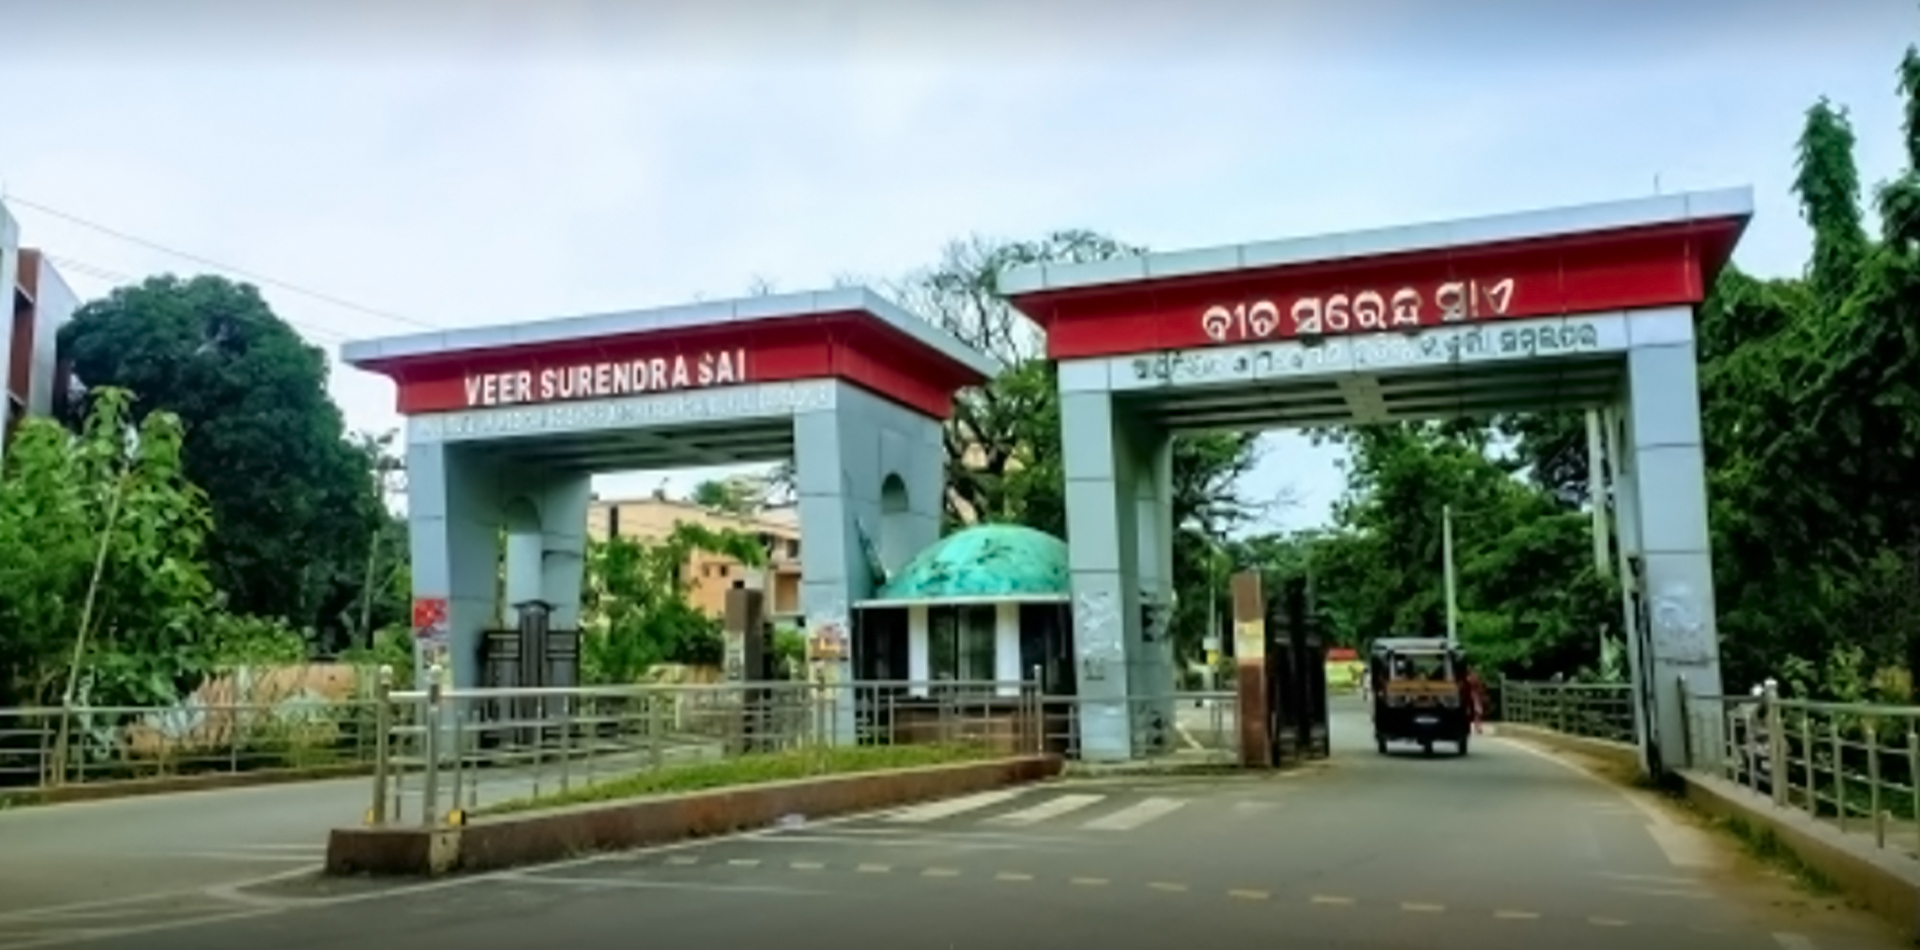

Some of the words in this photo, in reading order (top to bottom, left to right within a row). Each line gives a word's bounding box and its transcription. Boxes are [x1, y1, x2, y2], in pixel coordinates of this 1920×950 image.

[464, 370, 532, 407] VEER
[540, 355, 691, 400] SURENDRA
[698, 349, 746, 384] SAI
